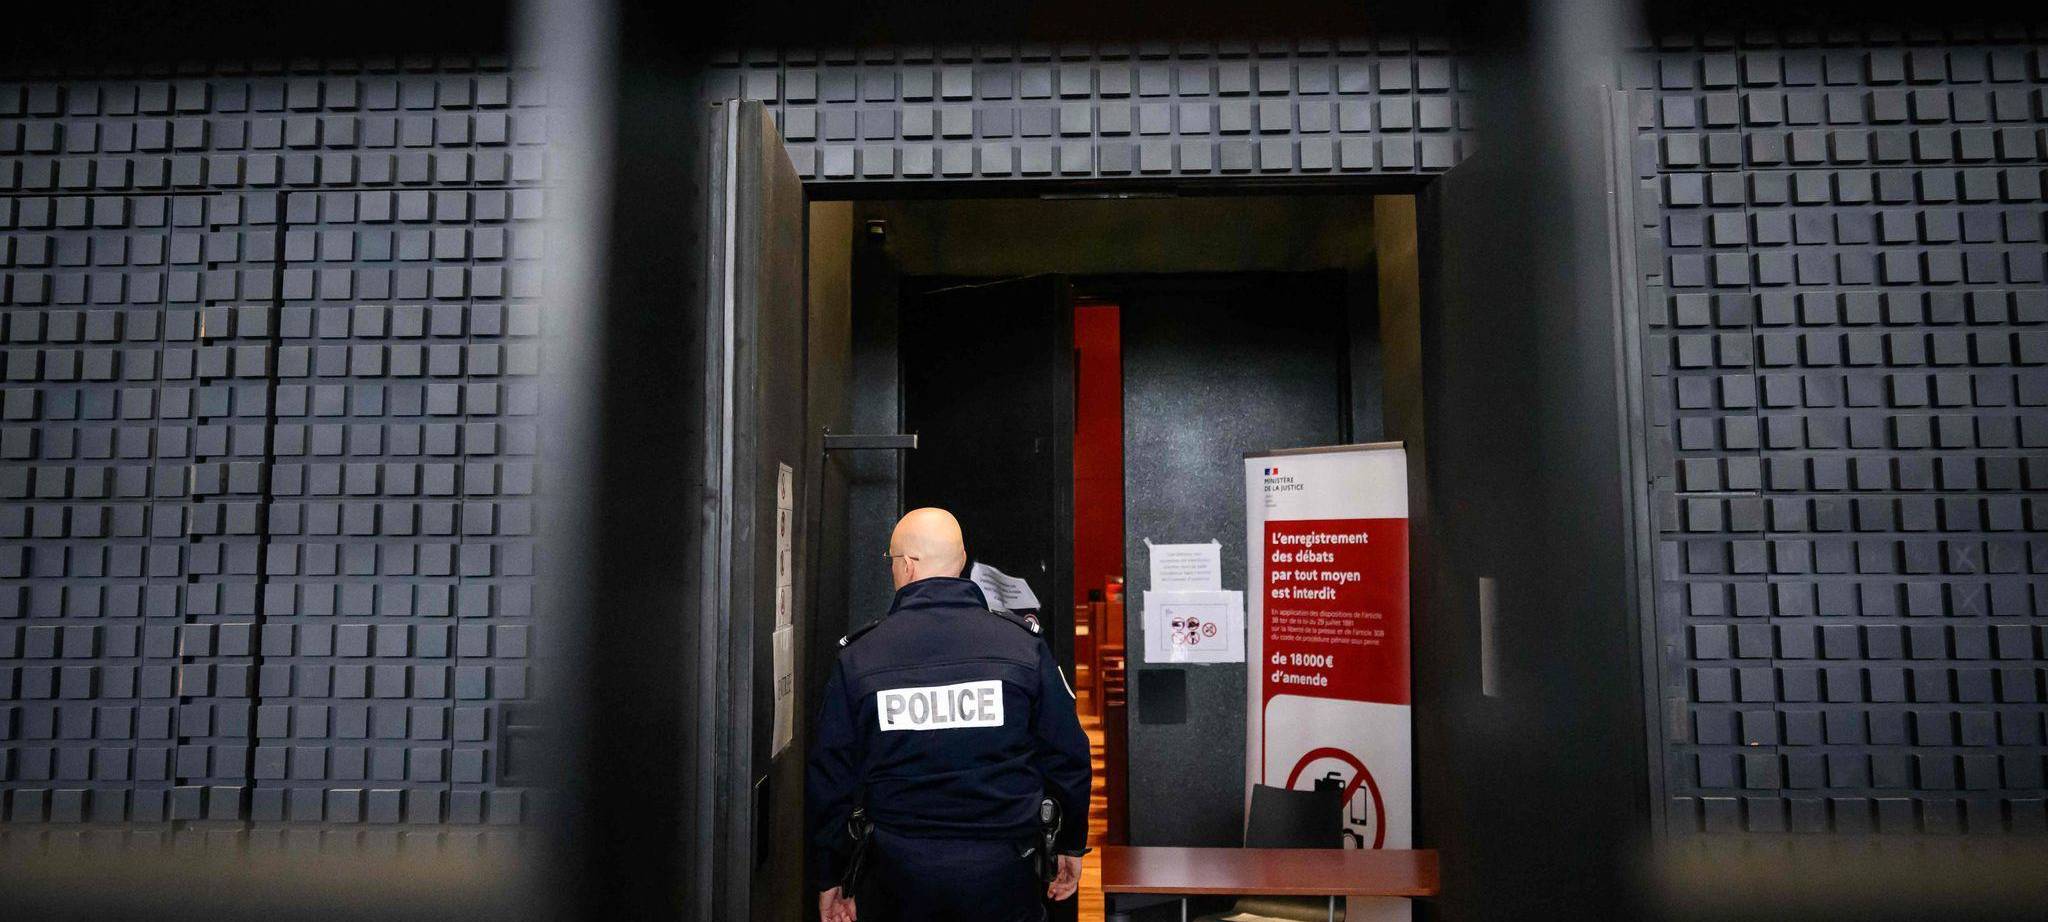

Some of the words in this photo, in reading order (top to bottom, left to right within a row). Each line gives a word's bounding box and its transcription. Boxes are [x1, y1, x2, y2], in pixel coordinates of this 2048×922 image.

[1264, 476, 1294, 484] MINISTÈRE
[1280, 484, 1304, 492] JUSTICE
[1272, 531, 1369, 547] L'enregistrement
[1271, 549, 1293, 562] des
[1295, 549, 1335, 563] débats
[1271, 570, 1292, 584] par
[1294, 569, 1318, 581] tout
[1321, 570, 1361, 585] moyen
[1271, 587, 1290, 599] est
[1293, 586, 1336, 600] interdit
[1280, 609, 1309, 617] application
[1320, 610, 1353, 619] dispositions
[1271, 651, 1287, 665] de
[1271, 670, 1328, 687] d'amende
[885, 688, 996, 725] POLICE
